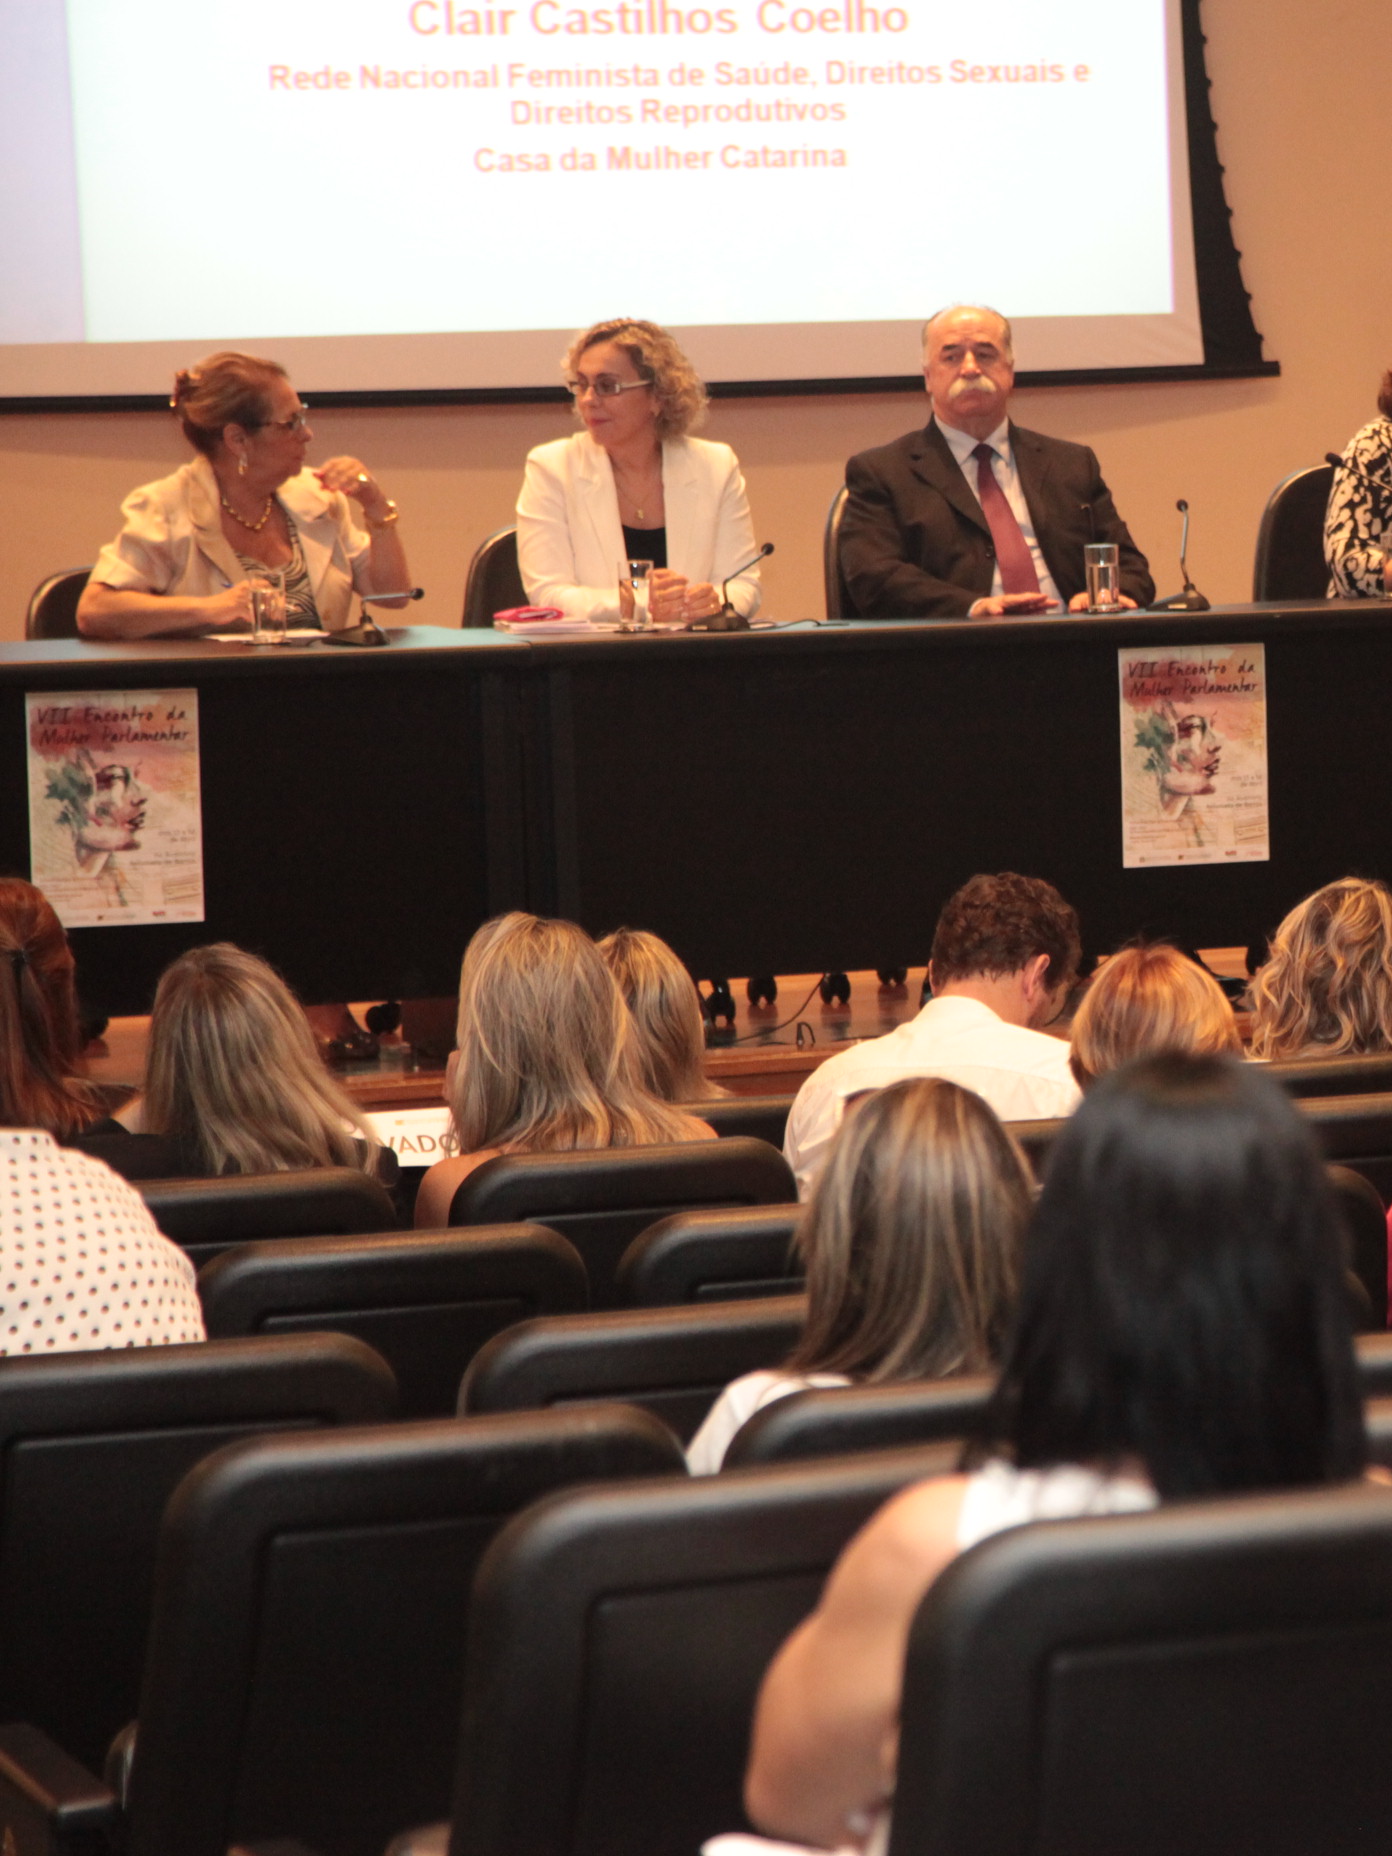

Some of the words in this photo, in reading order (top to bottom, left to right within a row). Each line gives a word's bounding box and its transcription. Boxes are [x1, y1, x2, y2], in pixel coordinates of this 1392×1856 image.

[408, 0, 516, 35] Clair
[529, 0, 738, 35] Castilhos
[756, 0, 908, 34] Coelho
[268, 64, 351, 91] Rede
[359, 63, 499, 90] Nacional
[507, 62, 661, 88] Feminista
[668, 62, 704, 87] de
[714, 60, 818, 89] Saúde,
[825, 60, 942, 85] Direitos
[949, 58, 1065, 84] Sexuais
[1073, 63, 1090, 83] e
[511, 99, 633, 125] Direitos
[641, 97, 847, 128] Reprodutivos
[473, 147, 552, 173] Casa
[559, 147, 597, 172] da
[606, 145, 713, 171] Mulher
[720, 143, 847, 169] Catarina
[1128, 661, 1158, 679] VII
[1166, 659, 1227, 677] Encontro
[1238, 659, 1256, 673] da
[1130, 681, 1174, 698] Mulher
[1182, 676, 1258, 696] Parlamentar
[37, 706, 71, 725] VII
[84, 704, 154, 723] Encontro
[166, 705, 186, 720] da
[40, 727, 91, 746] Mulher
[101, 724, 189, 744] Parlamentar
